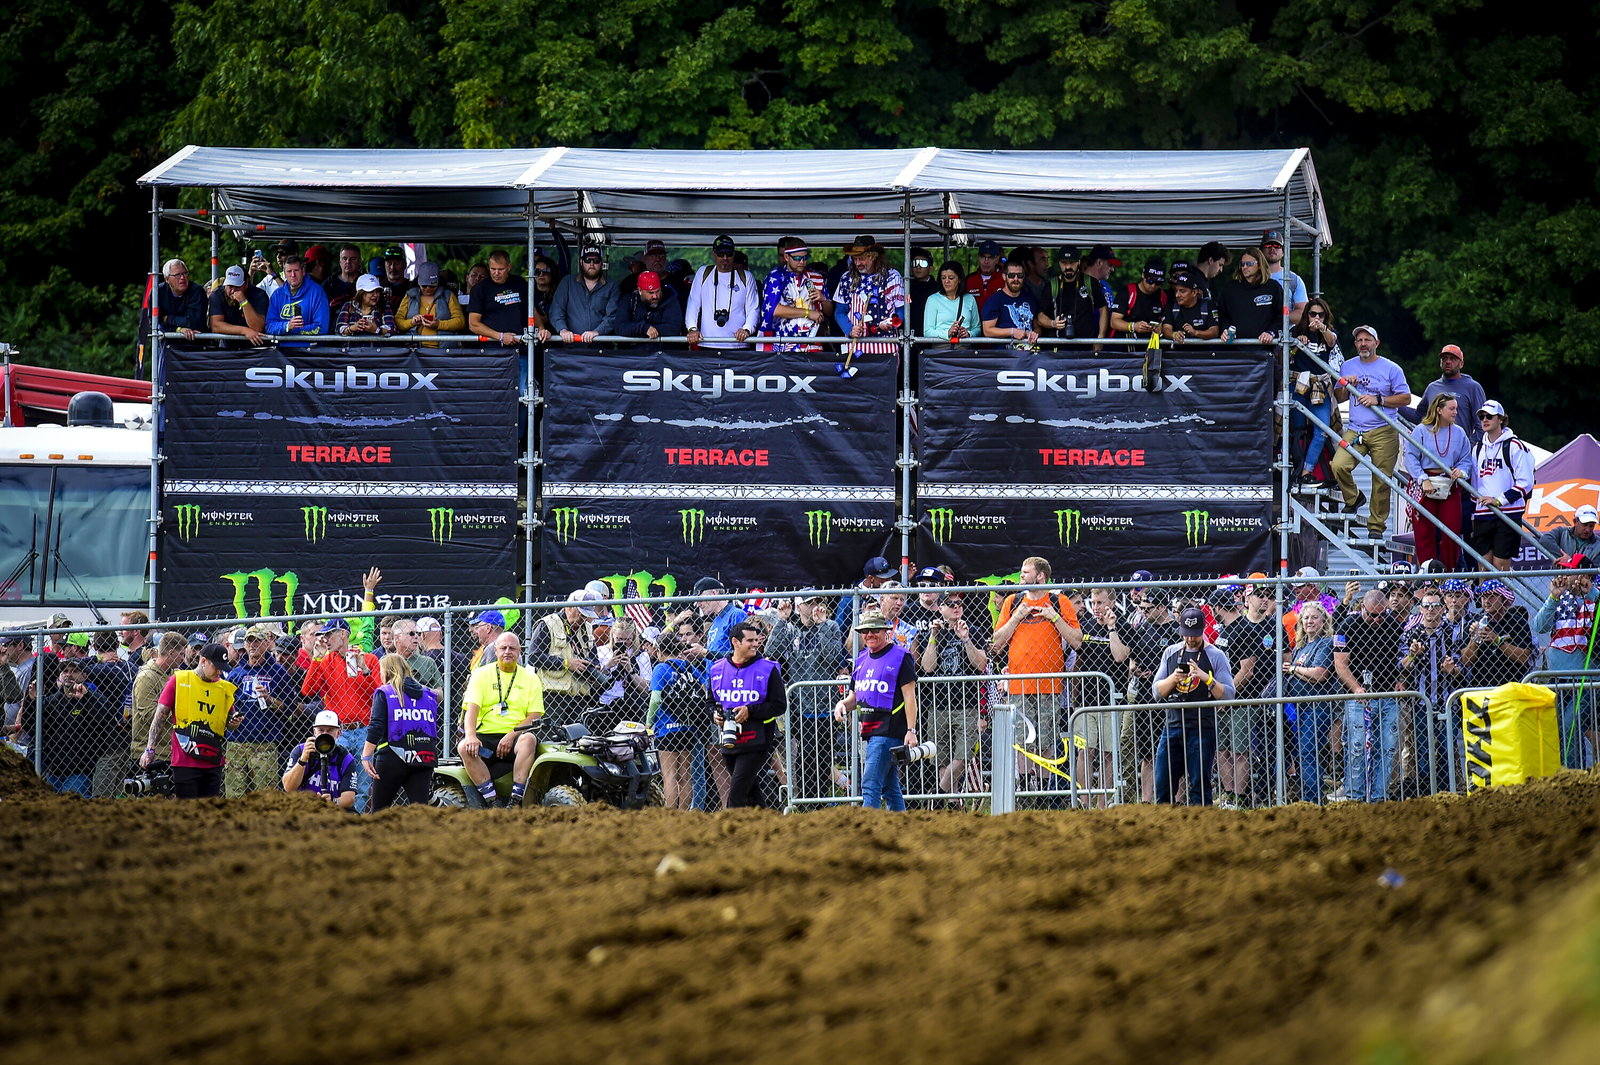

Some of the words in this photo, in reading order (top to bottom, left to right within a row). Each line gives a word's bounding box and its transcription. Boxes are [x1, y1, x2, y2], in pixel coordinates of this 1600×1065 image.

[245, 364, 439, 393] Skybox
[622, 367, 817, 399] Skybox
[287, 445, 391, 463] TERRACE
[664, 448, 769, 467] TERRACE
[1039, 448, 1145, 467] TERRACE
[201, 510, 254, 521] MONSTER
[327, 512, 380, 523] MONSTER
[454, 514, 507, 525] MONSTER
[579, 513, 631, 524] MONSTER
[705, 511, 758, 526] MONSTER
[954, 514, 1007, 525] MONSTER
[1081, 515, 1134, 527] MONSTER
[1209, 516, 1263, 527] MONSTER
[832, 516, 885, 528] MONSTER
[731, 679, 744, 688] 12
[197, 700, 216, 715] TV
[411, 698, 417, 707] 7
[394, 708, 435, 723] PHOTO
